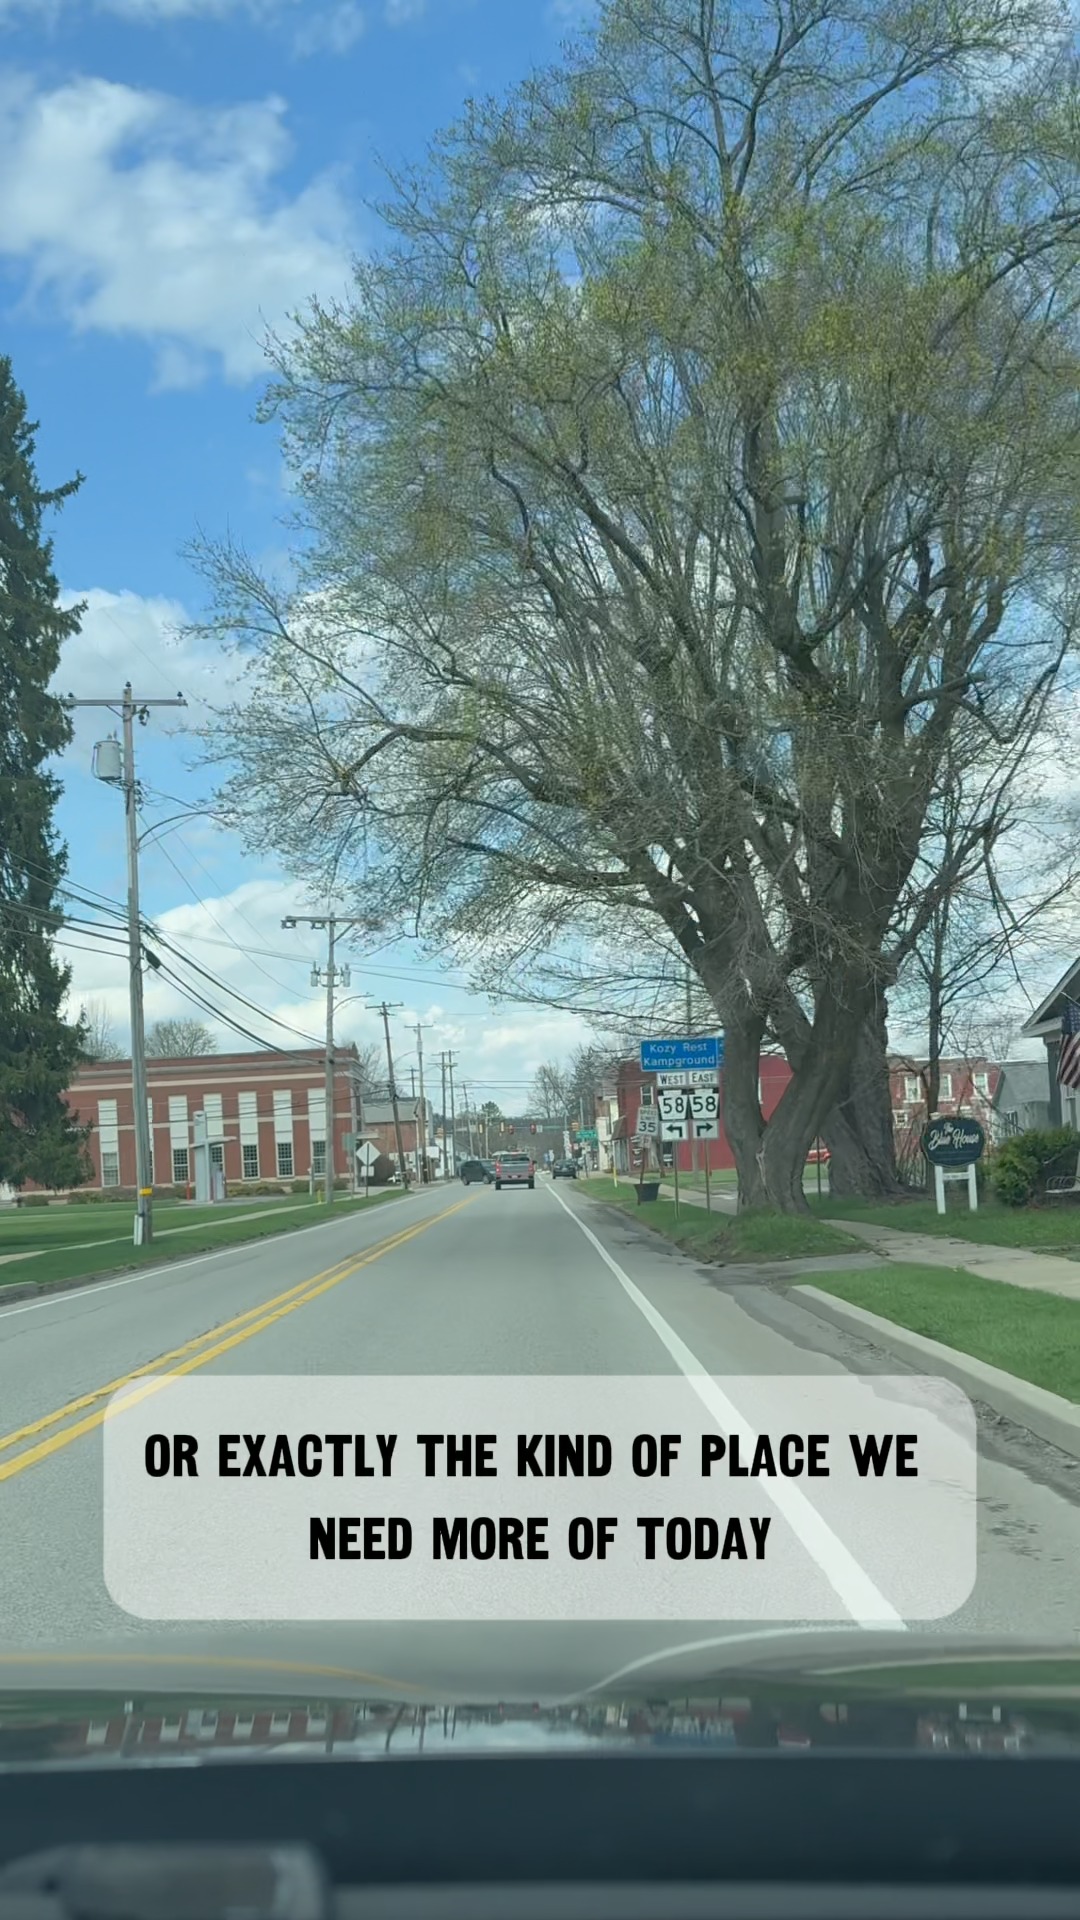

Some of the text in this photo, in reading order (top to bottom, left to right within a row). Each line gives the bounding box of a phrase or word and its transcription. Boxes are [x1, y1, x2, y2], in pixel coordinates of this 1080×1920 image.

[649, 1042, 707, 1054] Kozy Rest
[644, 1055, 715, 1067] Kampground
[660, 1074, 684, 1085] WEST
[692, 1072, 714, 1083] EAST
[663, 1097, 685, 1114] 58
[693, 1096, 716, 1113] 58
[639, 1121, 656, 1133] 35
[928, 1128, 979, 1150] Blue House
